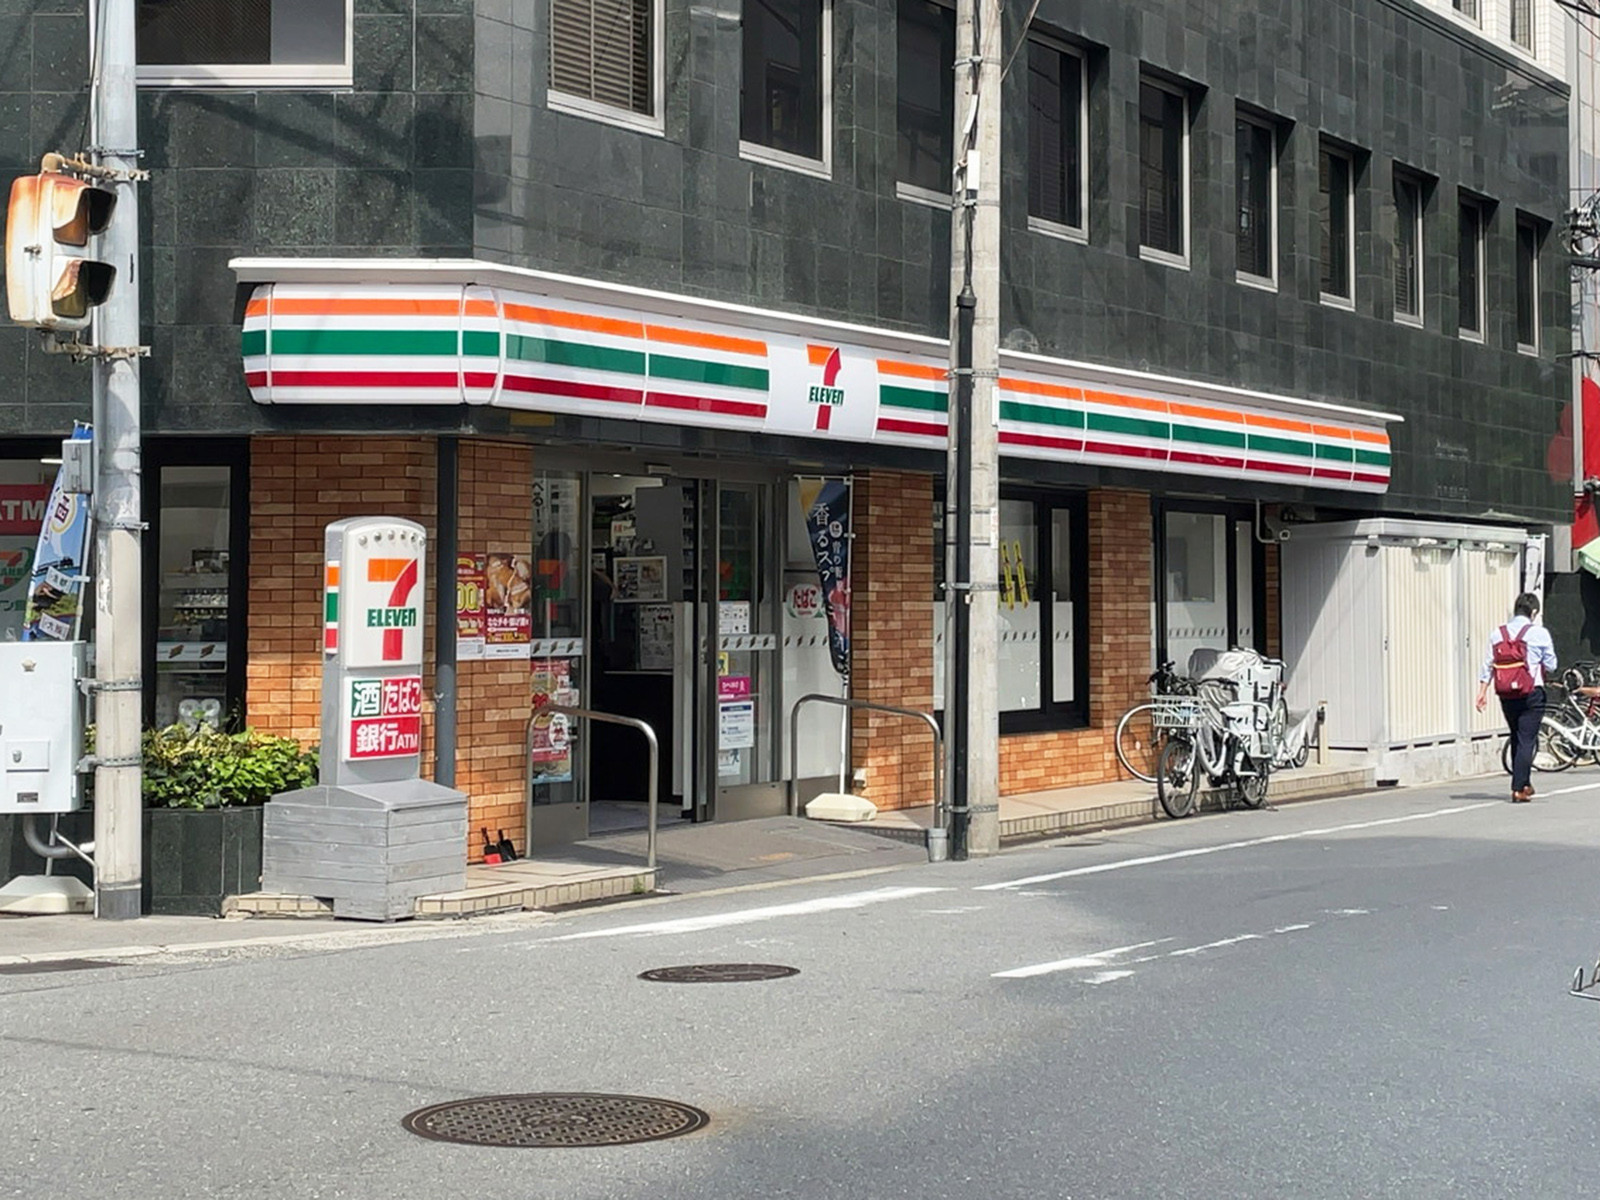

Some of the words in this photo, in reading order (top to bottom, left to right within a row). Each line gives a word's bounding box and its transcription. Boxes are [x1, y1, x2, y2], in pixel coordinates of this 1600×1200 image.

[807, 344, 841, 430] 7
[809, 386, 845, 406] ELEVEN
[367, 558, 418, 660] 7
[793, 588, 818, 609] たばこ
[367, 608, 417, 628] ELEVEN
[353, 681, 381, 717] 酒
[384, 680, 421, 715] たばこ
